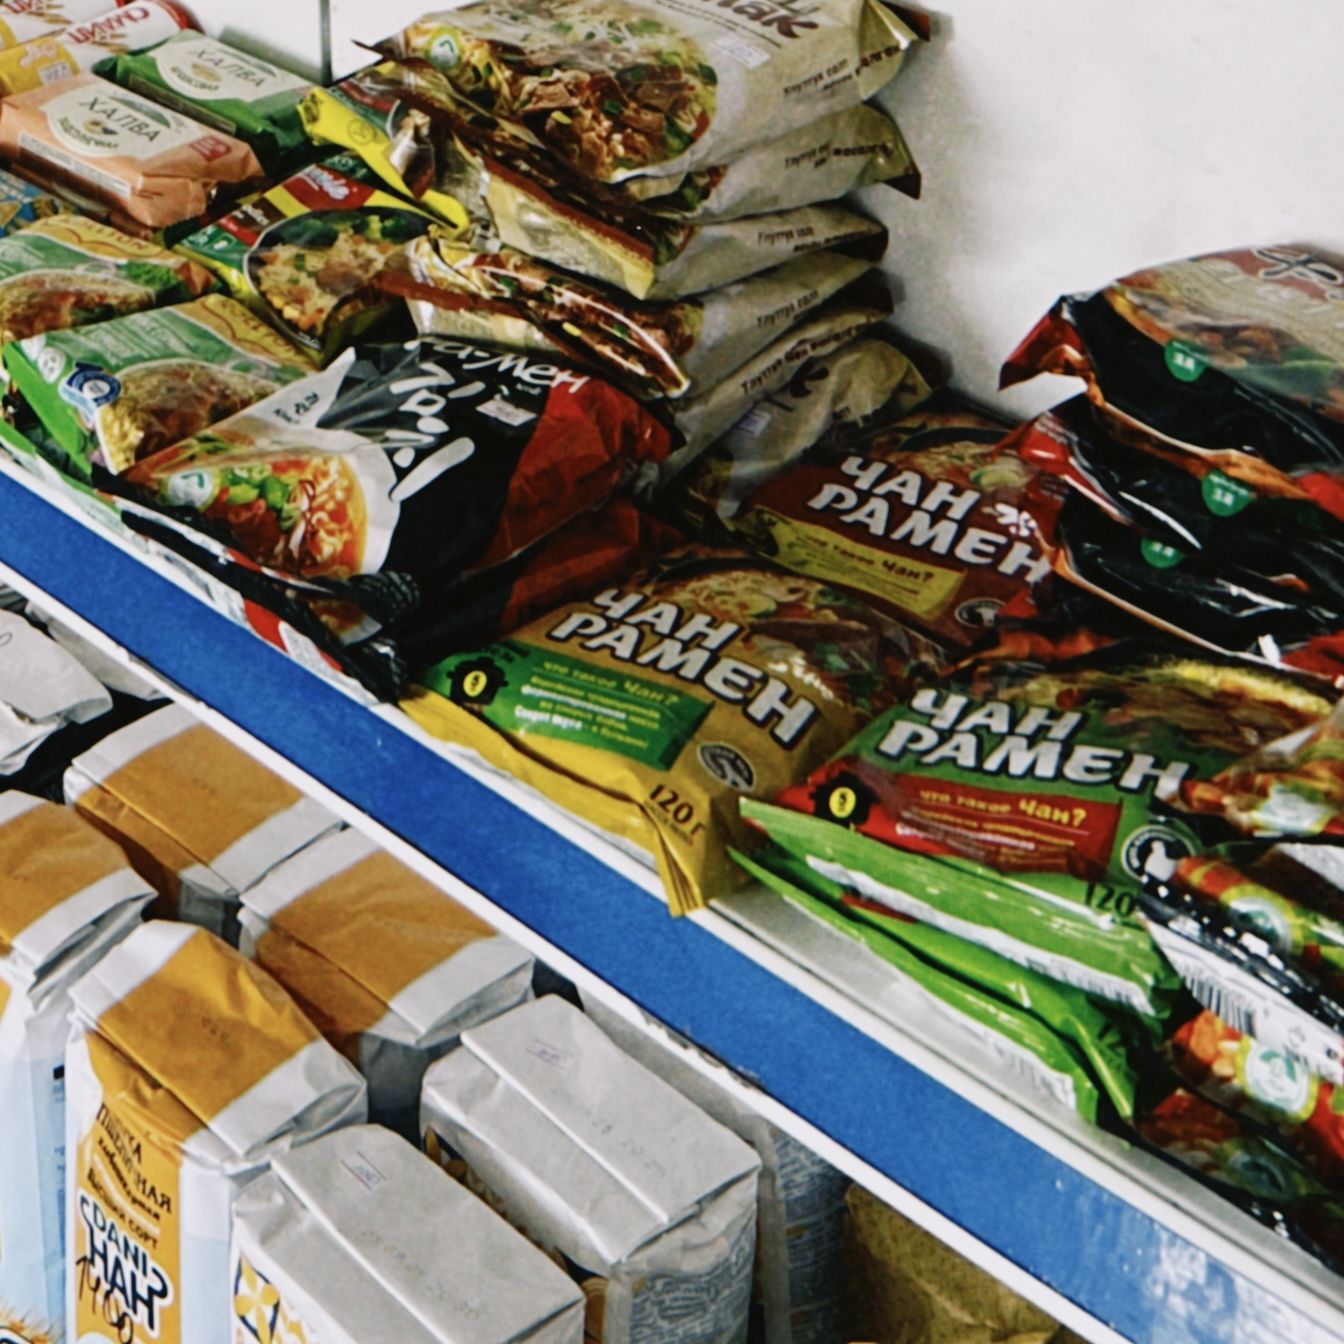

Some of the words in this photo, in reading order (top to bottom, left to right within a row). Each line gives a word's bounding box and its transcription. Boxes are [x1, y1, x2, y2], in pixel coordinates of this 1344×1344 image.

[187, 47, 267, 88] ХАЛВА
[78, 96, 162, 143] ХАЛВА
[837, 454, 980, 520] ЧАН
[807, 482, 1056, 584] РАМЕН
[589, 587, 740, 653] ЧАН
[549, 612, 817, 748] РАМЕН
[909, 688, 1086, 741] ЧАН
[877, 721, 1193, 792] РАМЕН
[648, 783, 696, 827] 120
[1018, 796, 1087, 827] Чан?
